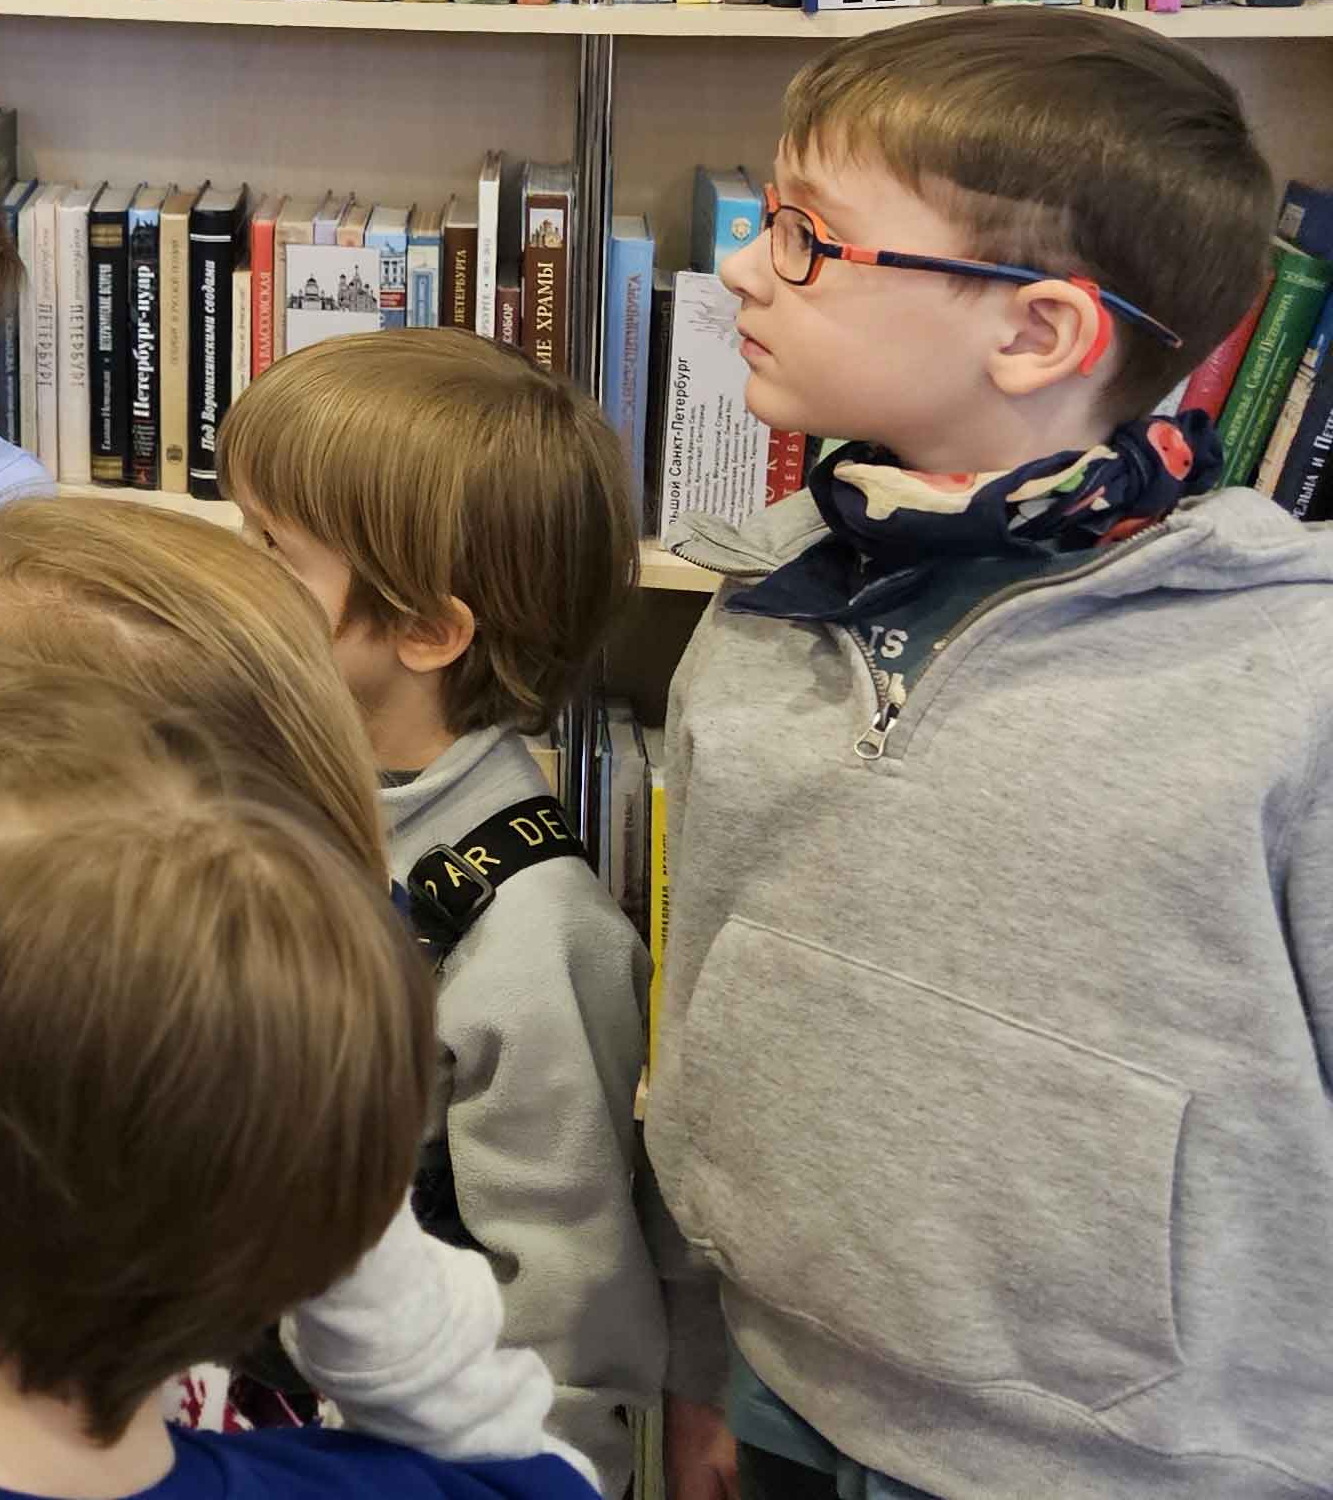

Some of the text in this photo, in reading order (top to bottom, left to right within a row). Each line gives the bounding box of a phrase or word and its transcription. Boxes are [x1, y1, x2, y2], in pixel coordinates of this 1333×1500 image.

[454, 249, 468, 325] ПЕТЕРБУРГА
[501, 303, 514, 344] СОБОР
[535, 261, 555, 331] ХРАМЫ
[36, 303, 53, 389] ПЕТЕРБУРГ
[70, 303, 86, 389] ПЕТЕРБУРГ
[131, 265, 155, 418] Петербург-нуар
[200, 259, 218, 453] Под Воронихинскими сводами
[668, 357, 689, 478] Санкт-Петербург
